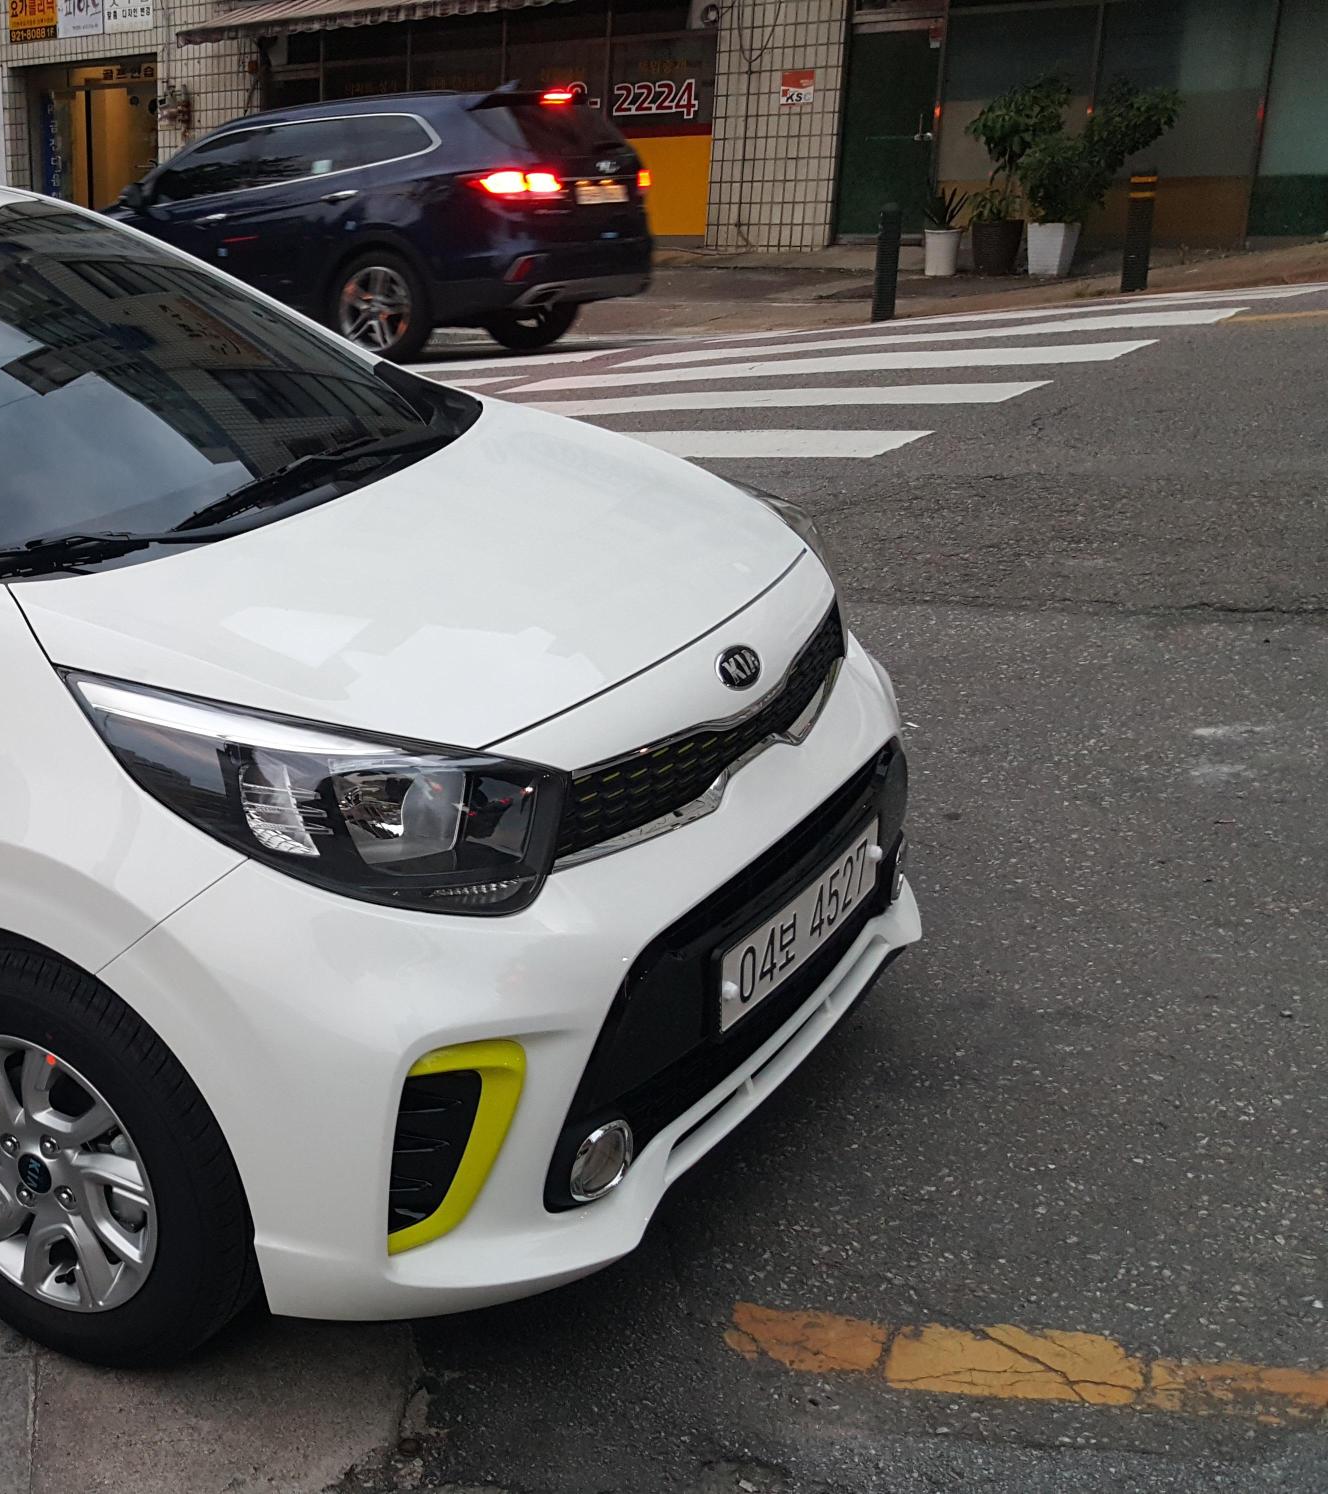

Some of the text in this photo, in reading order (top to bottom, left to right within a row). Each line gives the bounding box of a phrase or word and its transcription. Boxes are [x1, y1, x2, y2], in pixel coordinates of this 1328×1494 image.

[613, 78, 699, 119] 2224
[721, 649, 759, 685] KIA
[739, 837, 868, 1004] 04보 4527
